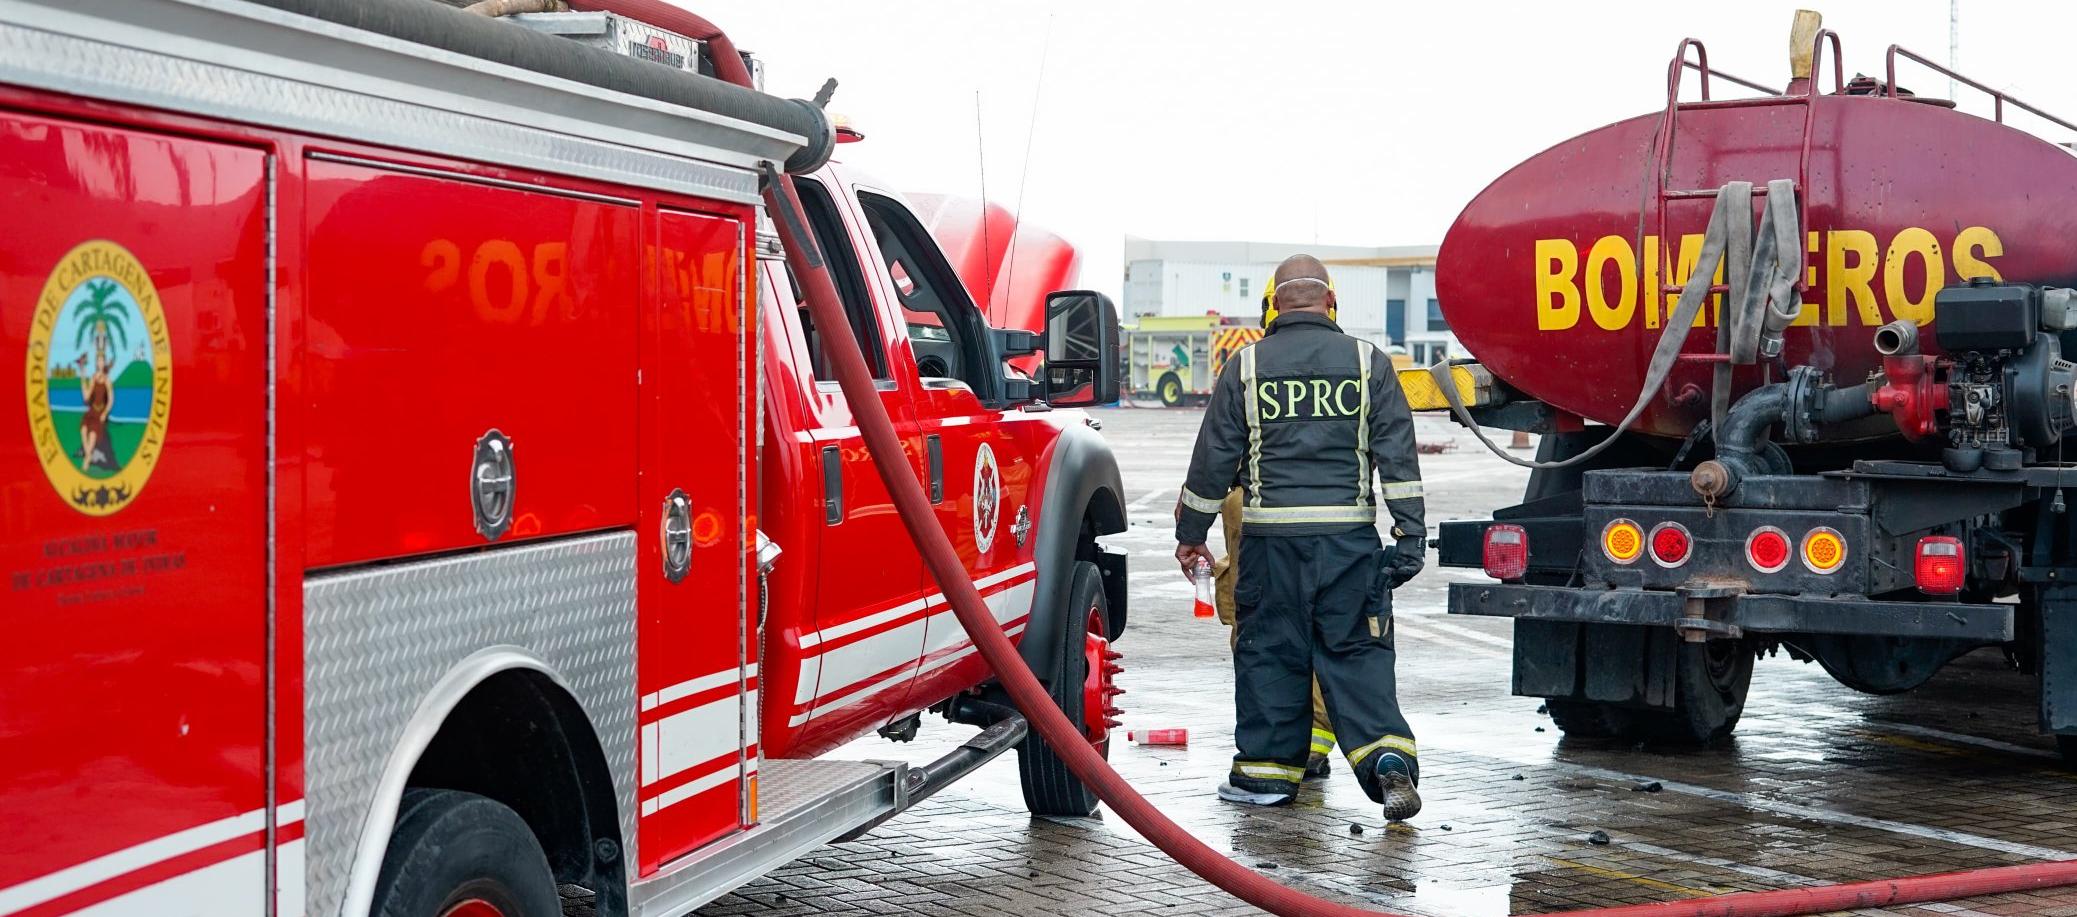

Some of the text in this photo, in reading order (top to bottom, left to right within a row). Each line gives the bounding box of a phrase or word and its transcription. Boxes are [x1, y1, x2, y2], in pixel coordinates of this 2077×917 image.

[31, 248, 169, 467] ESTADO DE CARTAGENA DE INDIAS
[1258, 379, 1361, 420] SPRC
